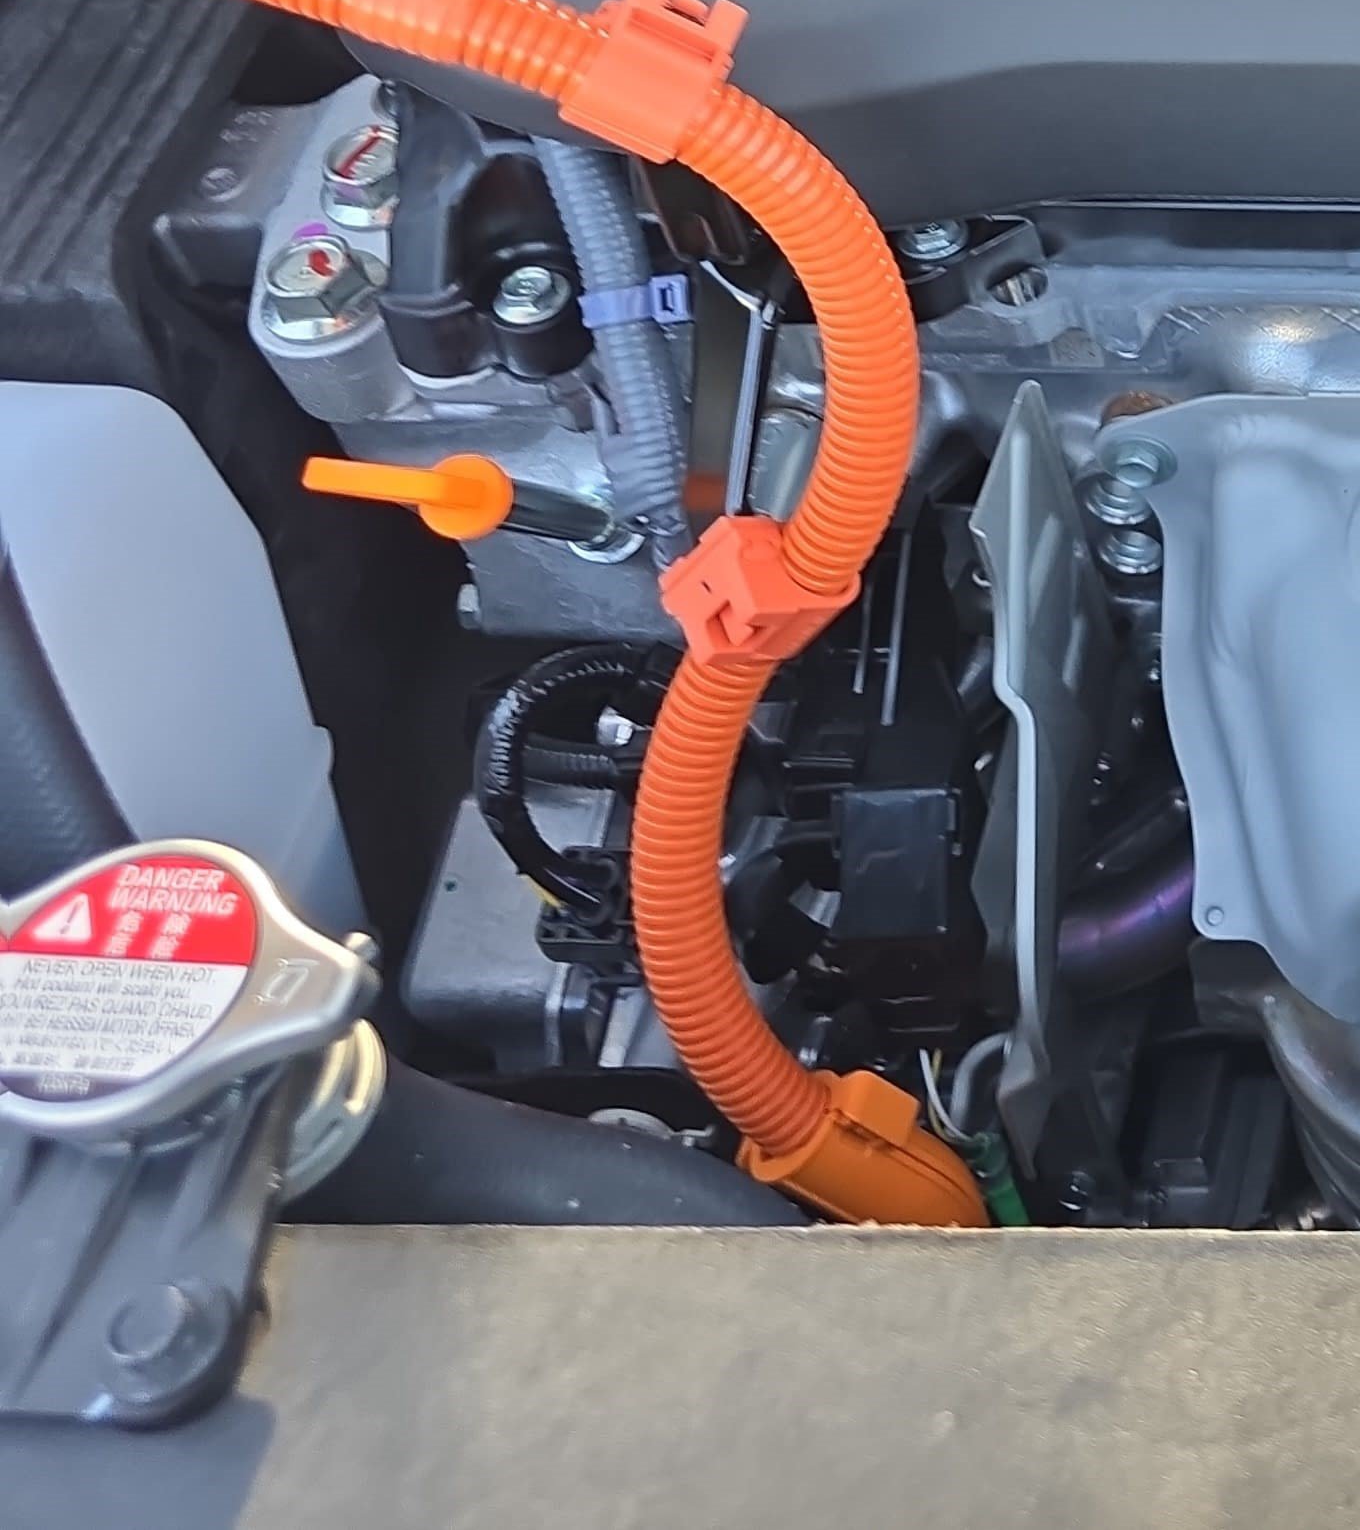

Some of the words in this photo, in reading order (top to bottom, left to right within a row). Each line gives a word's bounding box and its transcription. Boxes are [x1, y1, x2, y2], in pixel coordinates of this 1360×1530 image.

[118, 864, 225, 890] DANGER
[110, 888, 239, 916] WARNUNG
[81, 962, 122, 977] OPEN
[129, 965, 176, 981] WHEN
